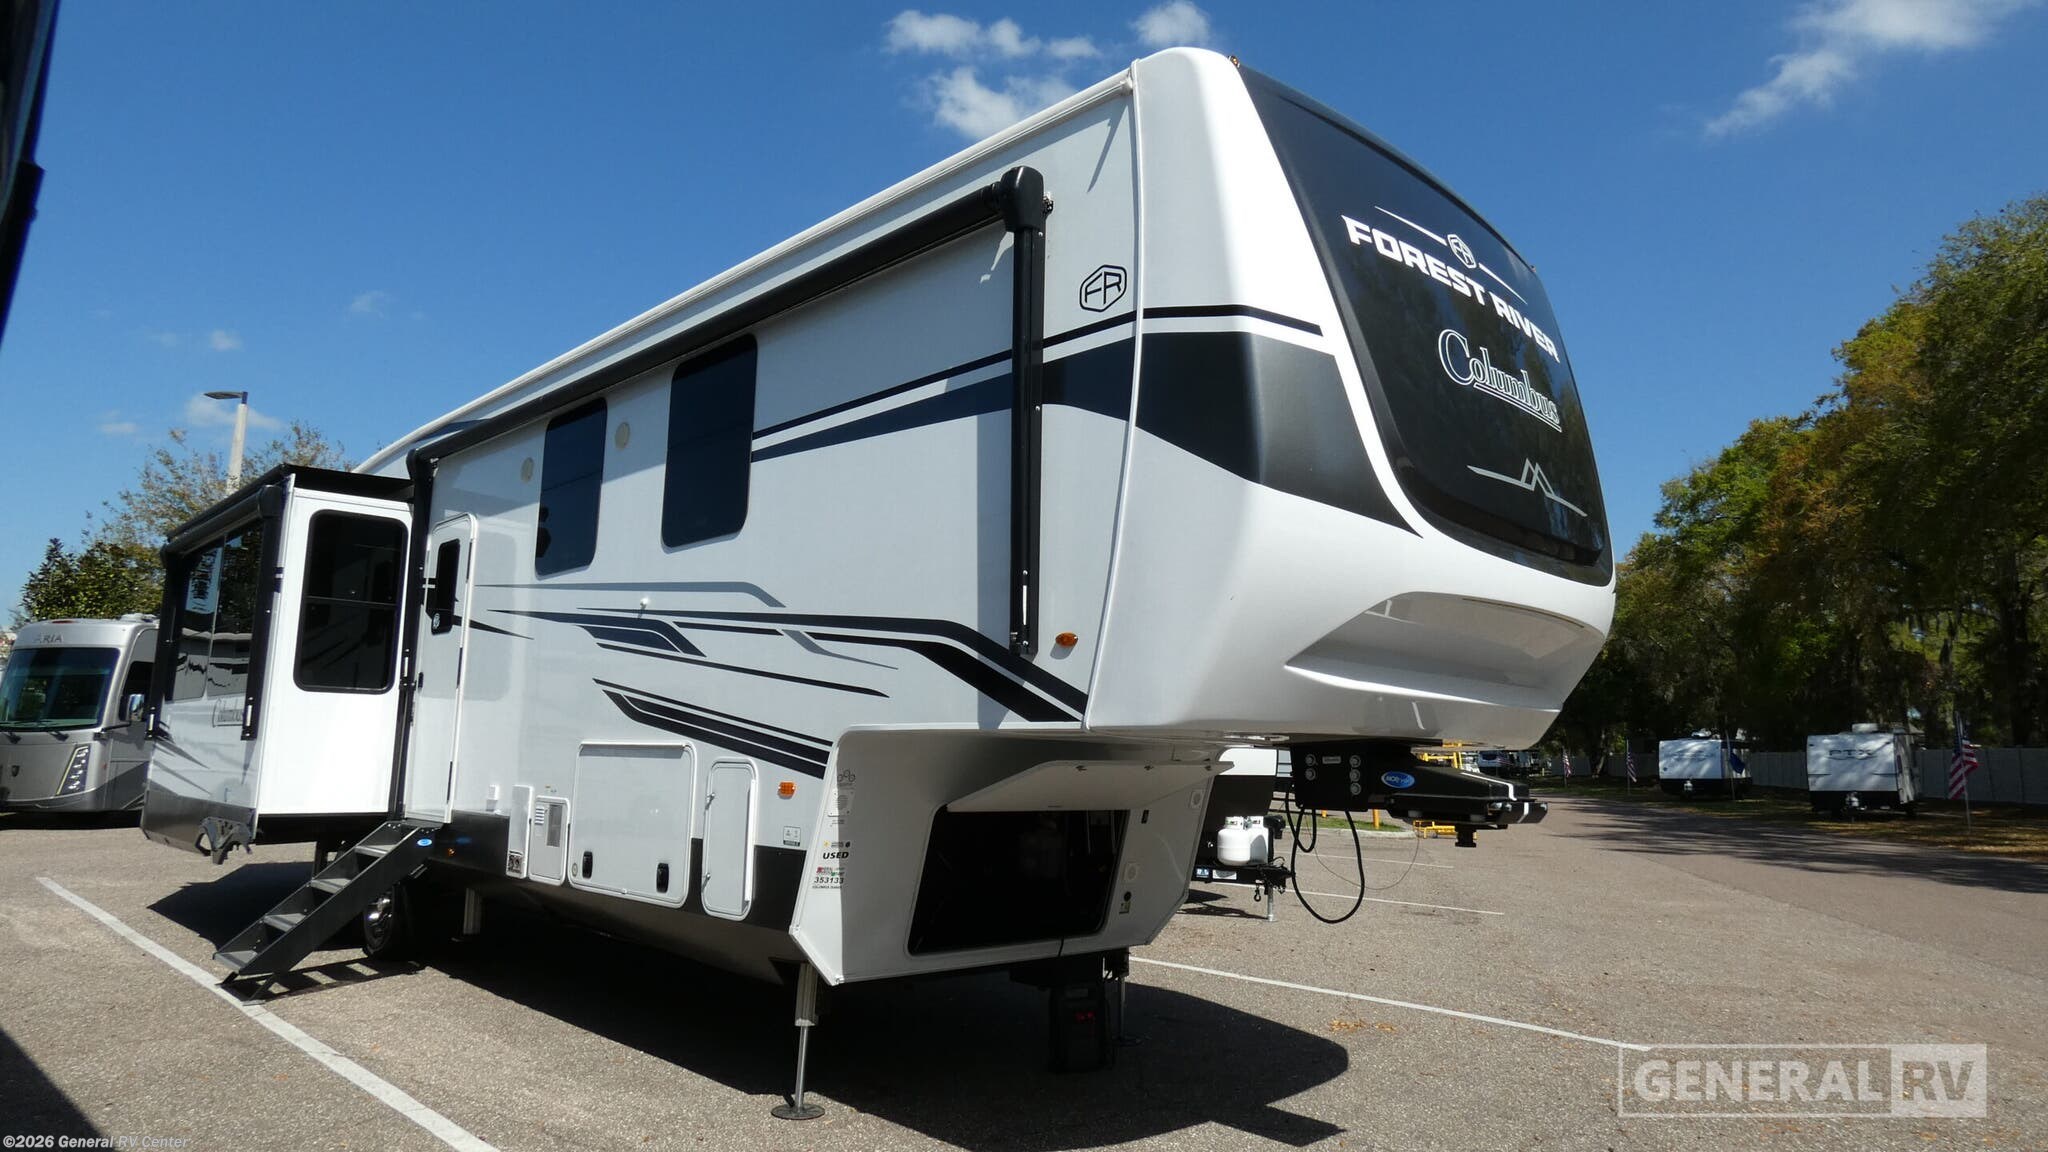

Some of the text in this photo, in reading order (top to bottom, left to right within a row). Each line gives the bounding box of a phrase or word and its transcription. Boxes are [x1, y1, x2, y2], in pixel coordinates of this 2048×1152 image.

[1341, 215, 1560, 363] FOREST RIVER
[1438, 328, 1561, 426] Columbus
[822, 851, 849, 860] USED
